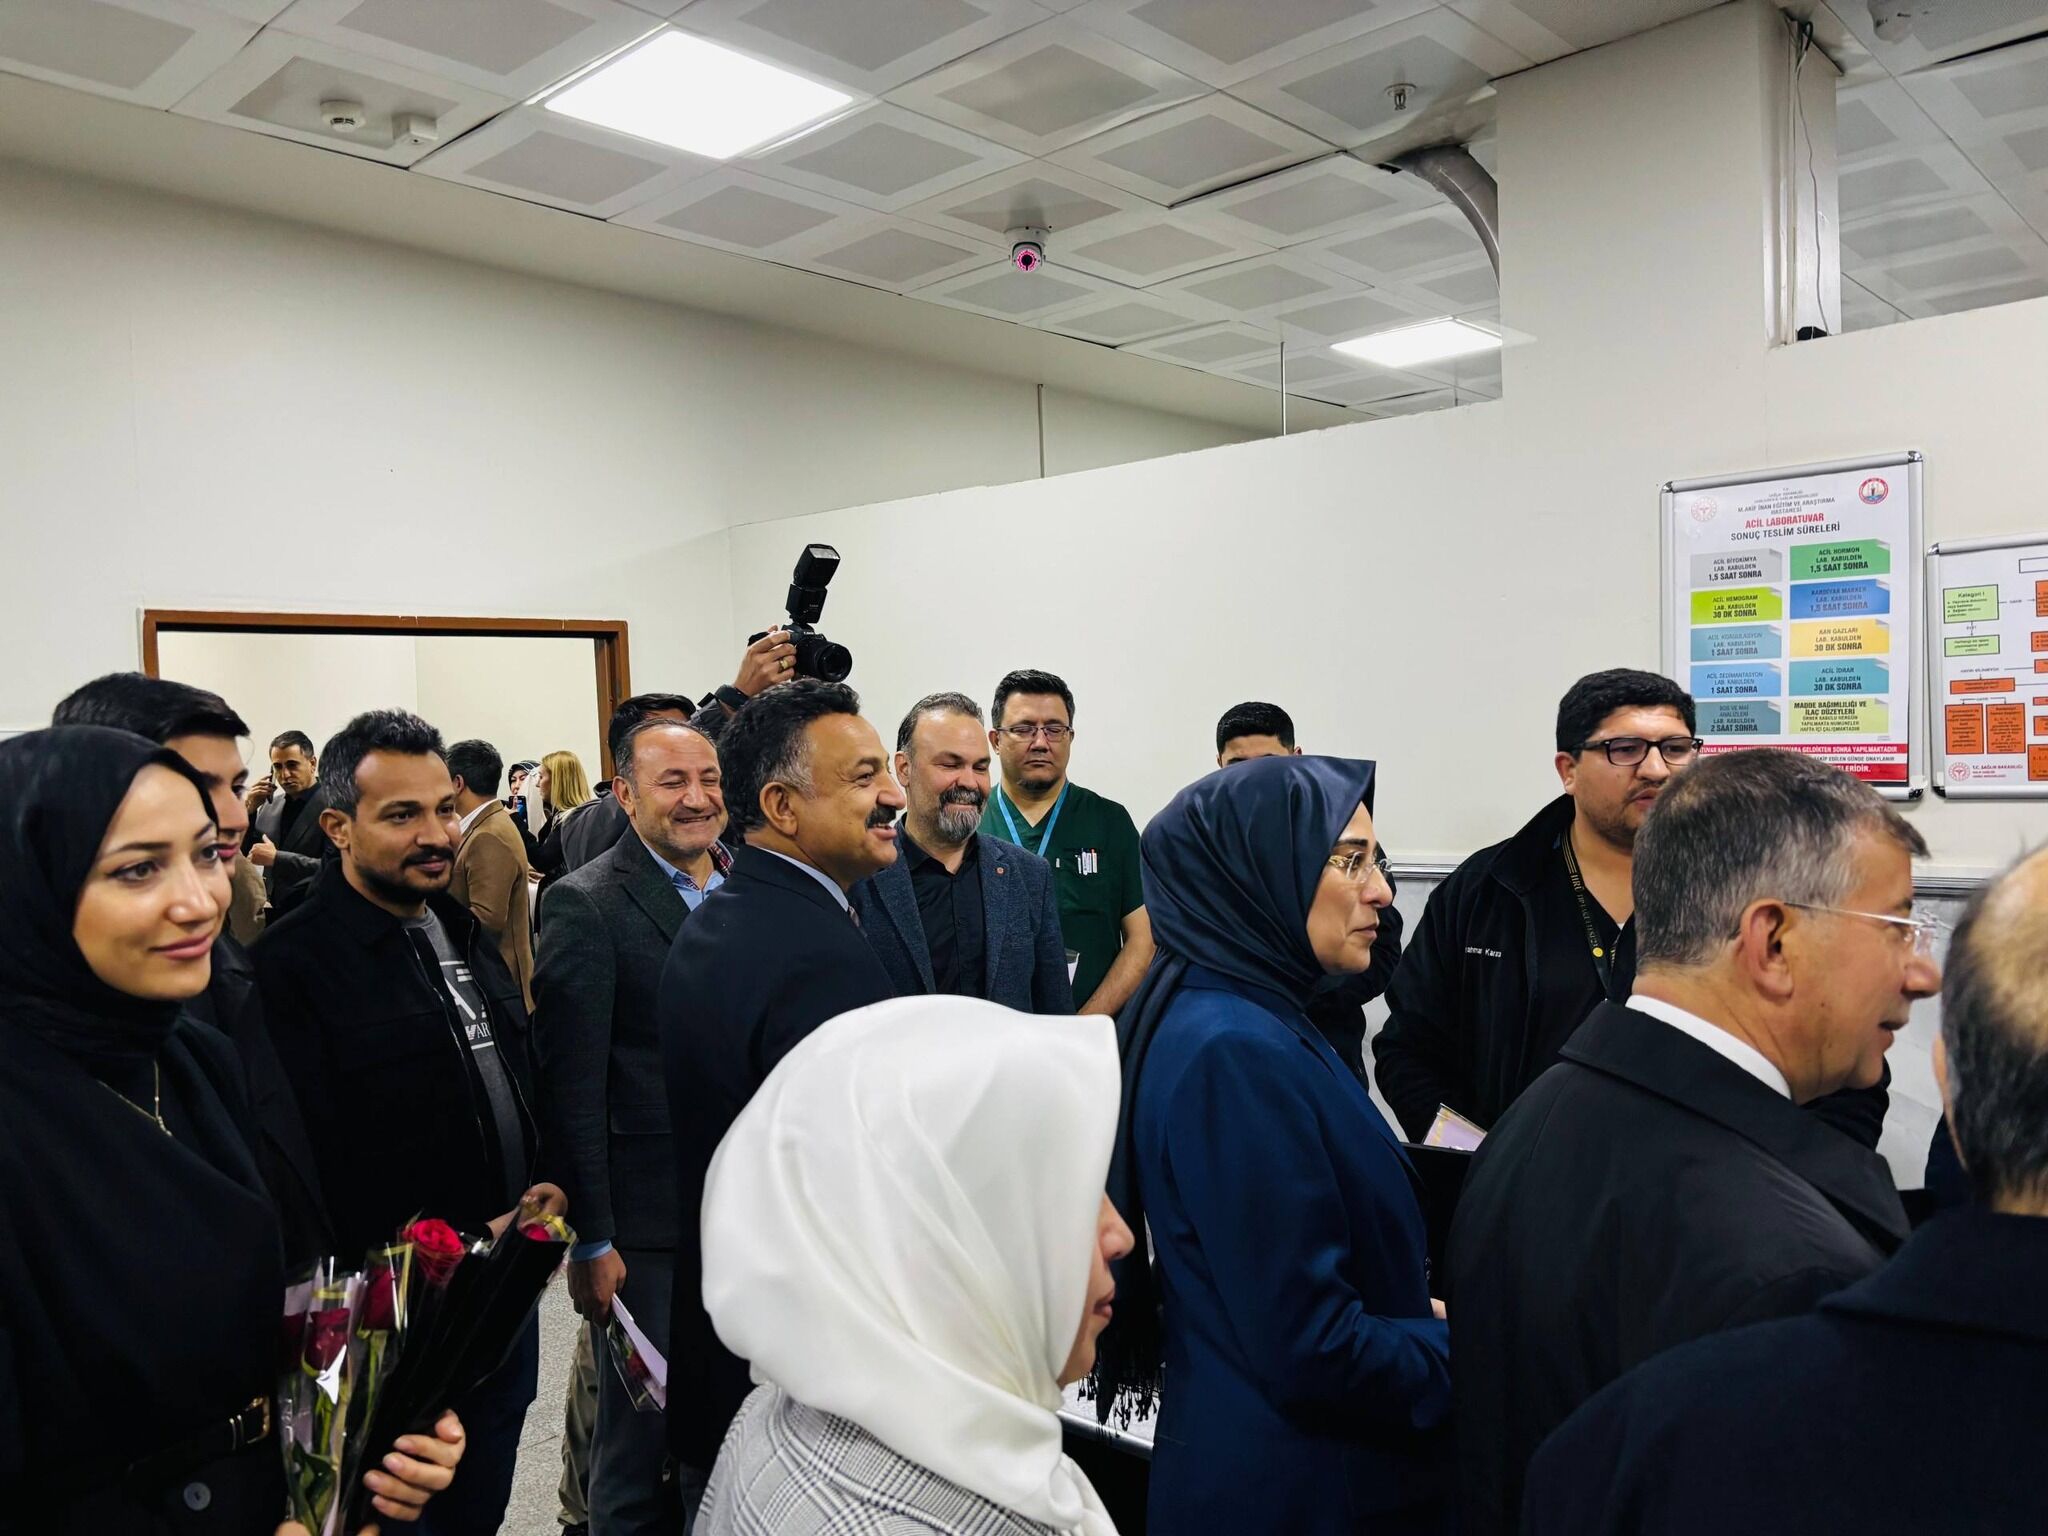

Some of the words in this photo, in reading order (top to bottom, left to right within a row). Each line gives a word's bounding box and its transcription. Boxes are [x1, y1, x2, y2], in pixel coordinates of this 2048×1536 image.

[1745, 519, 1764, 529] ACİL
[1766, 513, 1825, 527] LABORATUVAR
[1731, 531, 1760, 541] SONUÇ
[1763, 527, 1794, 539] TESLİM
[1797, 521, 1841, 535] SÜRELERİ
[1727, 556, 1757, 564] BİYOKİMYA
[1831, 554, 1863, 562] KABULDEN
[1728, 563, 1757, 571] KABULDEN
[1823, 563, 1841, 572] SAAT
[1843, 561, 1869, 570] SONRA
[1720, 572, 1737, 580] SAAT
[1739, 570, 1762, 579] SONRA
[1728, 602, 1757, 610] KABULDEN
[1713, 611, 1722, 619] 30
[1723, 610, 1733, 618] DK
[1734, 609, 1757, 617] SONRA
[1825, 643, 1836, 651] DK
[1837, 642, 1862, 650] SONRA
[1717, 648, 1733, 656] SAAT
[1735, 647, 1758, 655] SONRA
[1716, 686, 1733, 694] SAAT
[1735, 686, 1758, 694] SONRA
[1814, 683, 1823, 691] 30
[1825, 683, 1835, 691] DK
[1836, 682, 1862, 691] SONRA
[1818, 700, 1858, 709] BAĞIMLILIĞI
[1711, 724, 1715, 732] 2
[1716, 724, 1733, 732] SAAT
[1734, 724, 1758, 732] SONRA
[1802, 745, 1832, 753] GELDİKTEN
[1853, 745, 1898, 753] YAPILMAKTADIR
